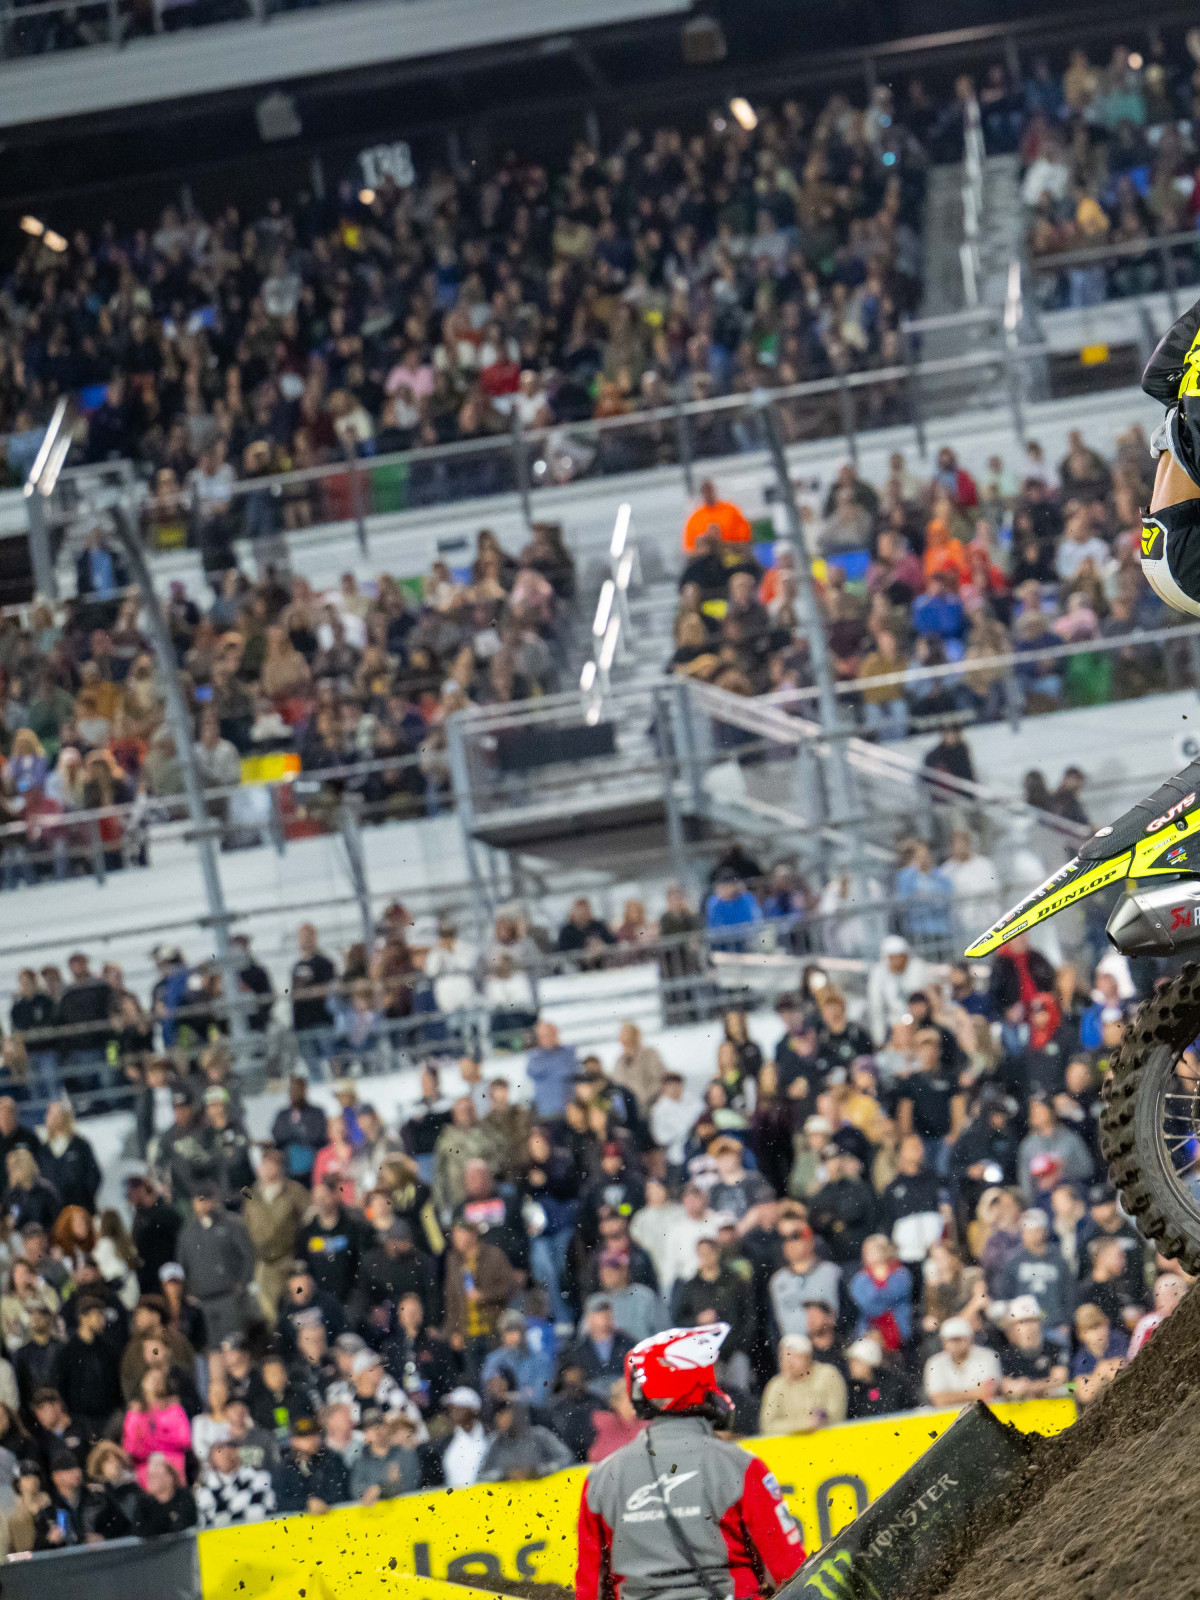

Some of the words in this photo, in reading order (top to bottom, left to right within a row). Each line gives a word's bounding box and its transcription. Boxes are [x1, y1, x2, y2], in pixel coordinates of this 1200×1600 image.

[1146, 792, 1196, 832] GUTS
[1036, 870, 1117, 919] DUNLOP
[856, 1472, 959, 1564] MONSTER
